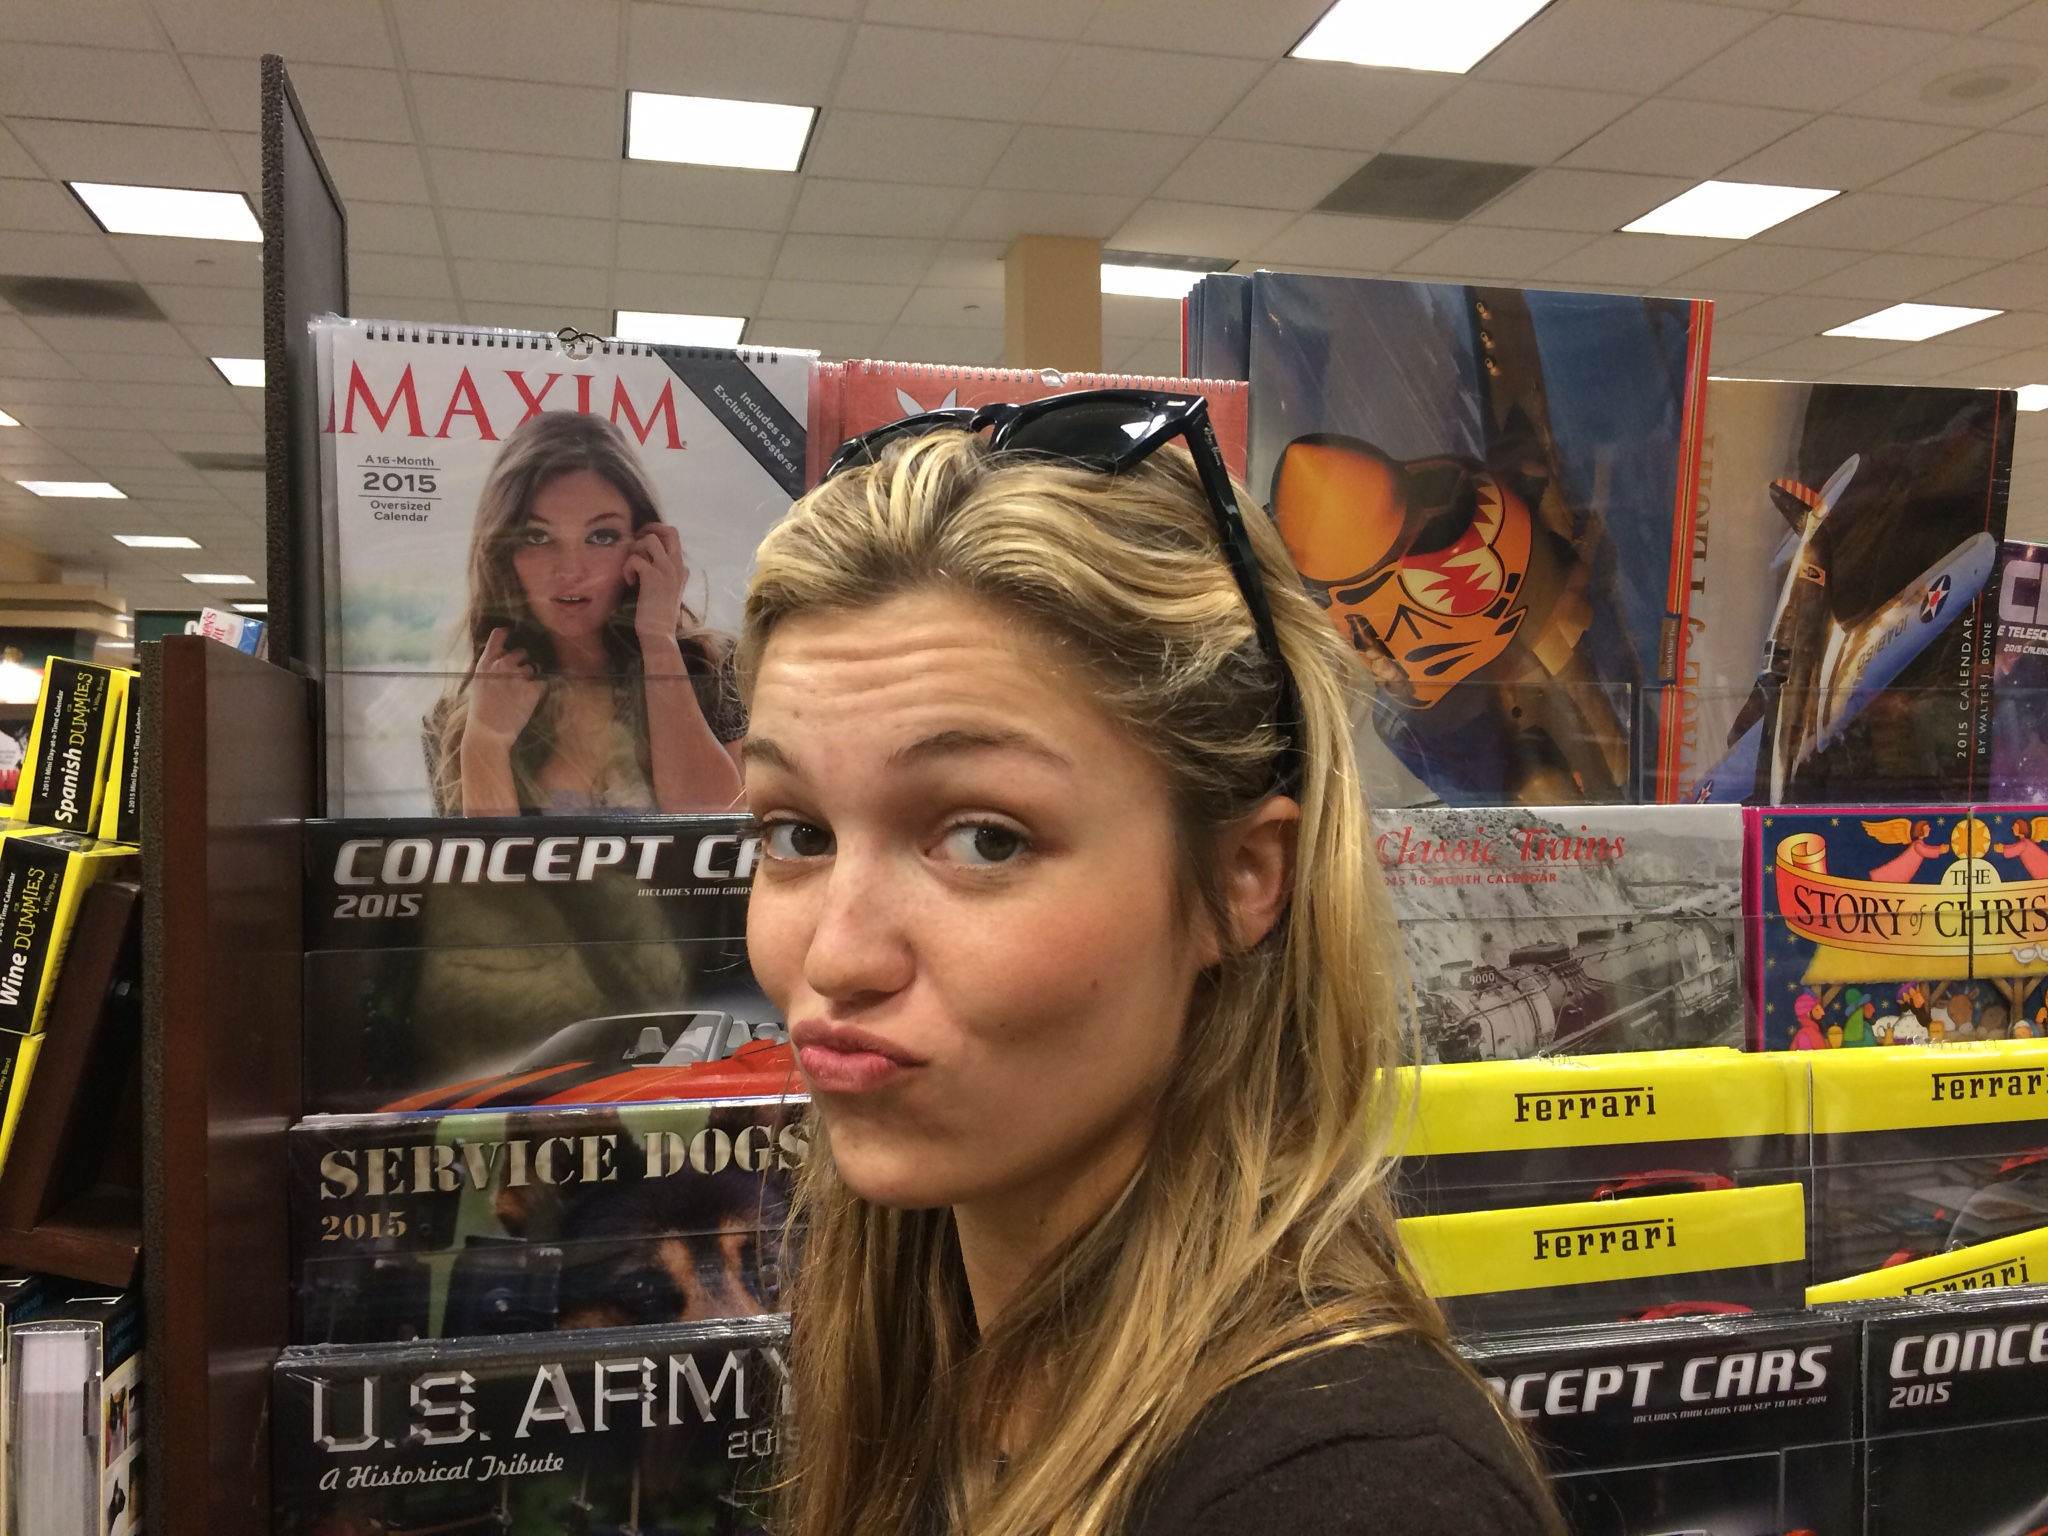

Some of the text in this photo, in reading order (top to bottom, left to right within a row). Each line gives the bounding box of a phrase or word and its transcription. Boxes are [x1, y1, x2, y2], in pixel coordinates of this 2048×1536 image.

[338, 359, 687, 450] MAXIM
[740, 391, 791, 447] Includes 13
[714, 384, 798, 473] Exclusive Posters!
[366, 455, 374, 464] A
[363, 472, 437, 493] 2015
[370, 500, 431, 511] Oversized
[374, 511, 428, 522] Calendar
[1981, 622, 1992, 665] BOYNE
[2004, 643, 2022, 653] 2015
[1957, 618, 1973, 758] 2015 CALENDAR
[1979, 683, 1989, 734] WALTER
[45, 760, 53, 776] Mini
[54, 689, 64, 720] Calendar
[55, 672, 93, 823] Spanish DUMMIES
[1978, 739, 1986, 754] BY
[333, 834, 675, 887] CONCEPT
[1376, 824, 1626, 866] Classic Trains
[4, 872, 16, 902] Calendar
[638, 888, 691, 897] INCLUDES
[693, 887, 720, 896] MINI
[1412, 873, 1480, 887] 16-MONTH
[1487, 872, 1558, 885] CALENDAR
[1950, 869, 1991, 886] THE
[333, 893, 423, 919] 2015
[1793, 884, 1905, 940] STORY
[1909, 904, 1927, 936] of
[0, 867, 45, 1006] Wine DUMMIES
[1469, 972, 1495, 985] 9000
[1931, 1066, 2048, 1101] Ferrar
[1514, 1086, 1657, 1123] Ferrari
[319, 1124, 809, 1201] SERVICE DOGS
[321, 1210, 408, 1243] 2015
[1533, 1217, 1677, 1261] Ferrari
[1679, 1344, 1833, 1403] CARS
[312, 1369, 491, 1453] U.S.
[1889, 1381, 1952, 1409] 2015
[1633, 1411, 1677, 1424] INCLUDES
[319, 1452, 564, 1491] A Historical Tribute
